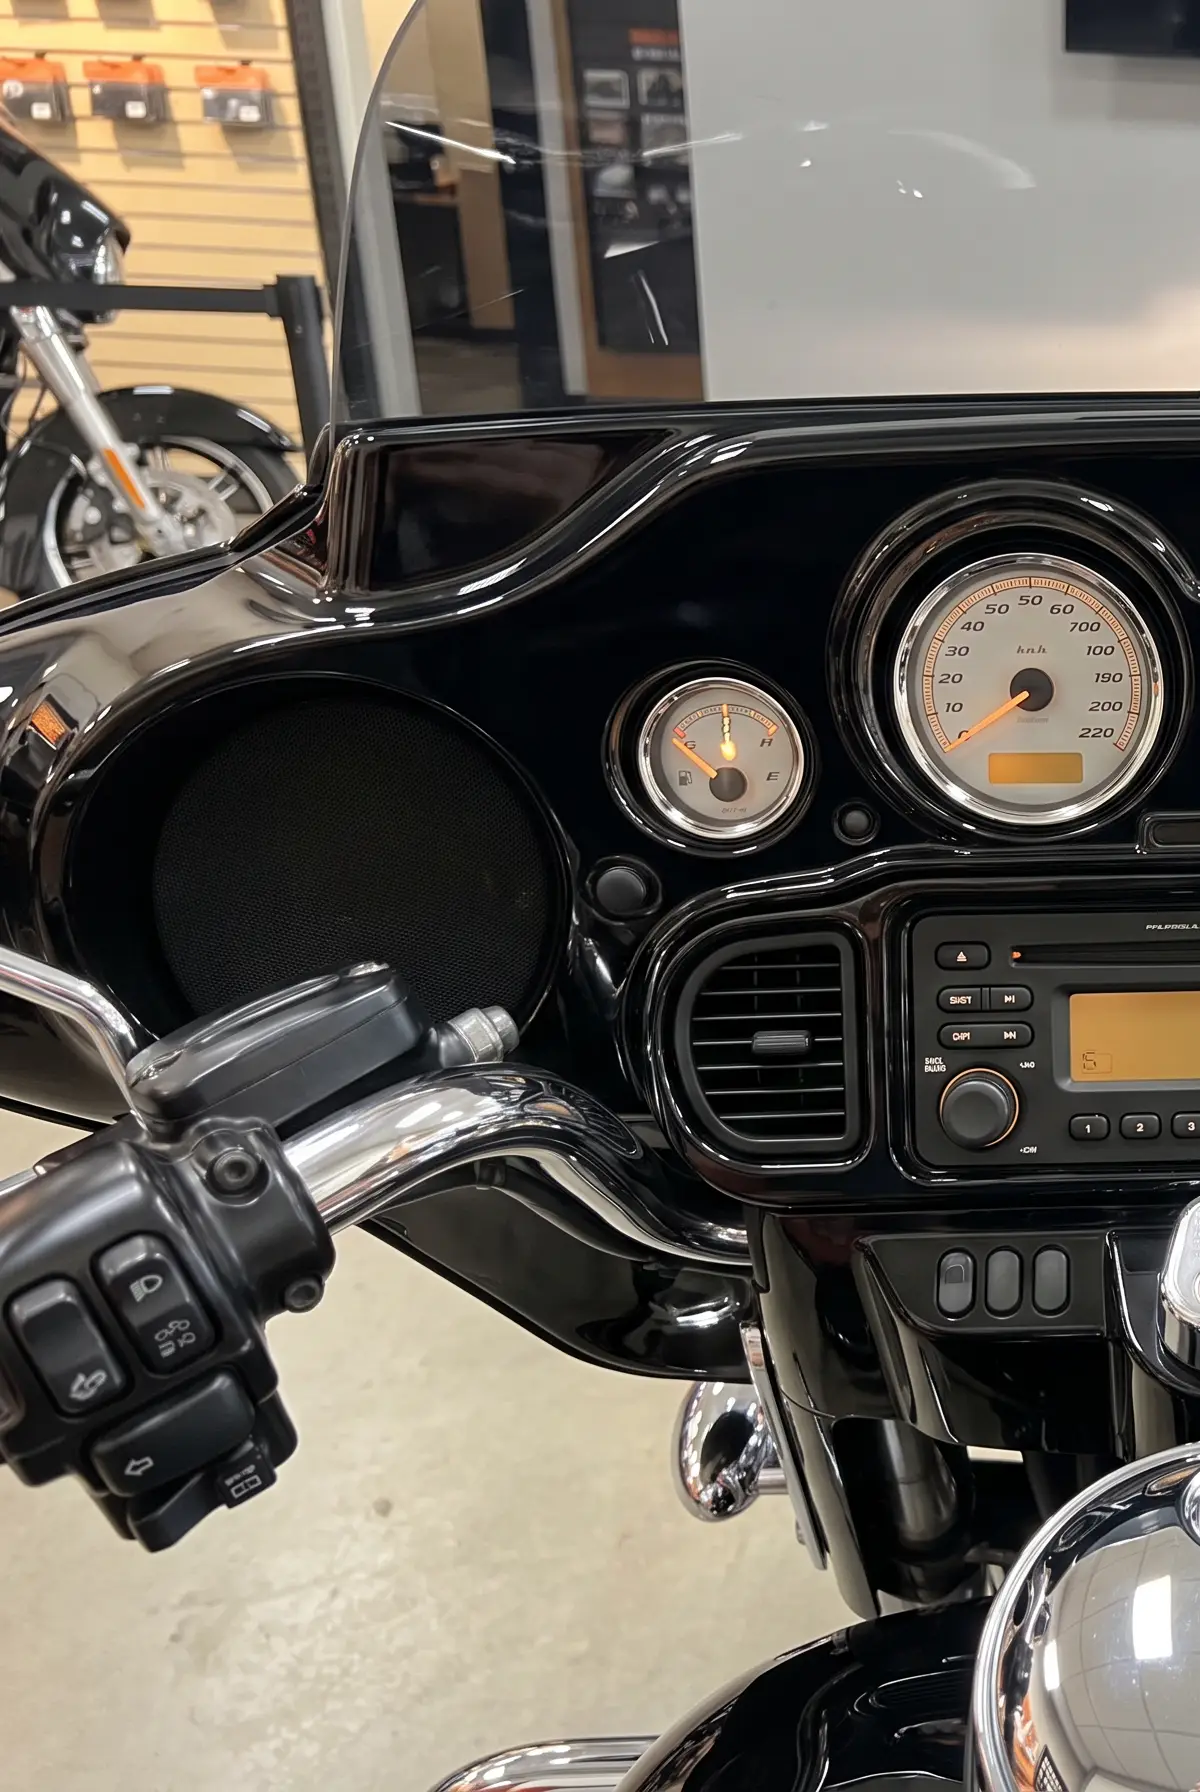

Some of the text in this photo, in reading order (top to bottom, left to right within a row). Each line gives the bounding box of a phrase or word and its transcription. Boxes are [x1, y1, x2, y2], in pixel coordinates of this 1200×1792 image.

[1018, 595, 1043, 606] 50
[984, 604, 1010, 615] 50
[1049, 604, 1075, 615] 60
[960, 621, 985, 632] 40
[1069, 621, 1101, 632] 700
[944, 646, 970, 657] 30
[1086, 645, 1115, 656] 100
[938, 673, 963, 684] 20
[1095, 672, 1123, 683] 190
[945, 702, 963, 713] 10
[1088, 701, 1123, 712] 200
[1078, 727, 1114, 738] 220
[766, 771, 780, 781] E
[1085, 1124, 1091, 1134] 1
[1136, 1123, 1144, 1132] 2
[1188, 1122, 1196, 1131] 3
